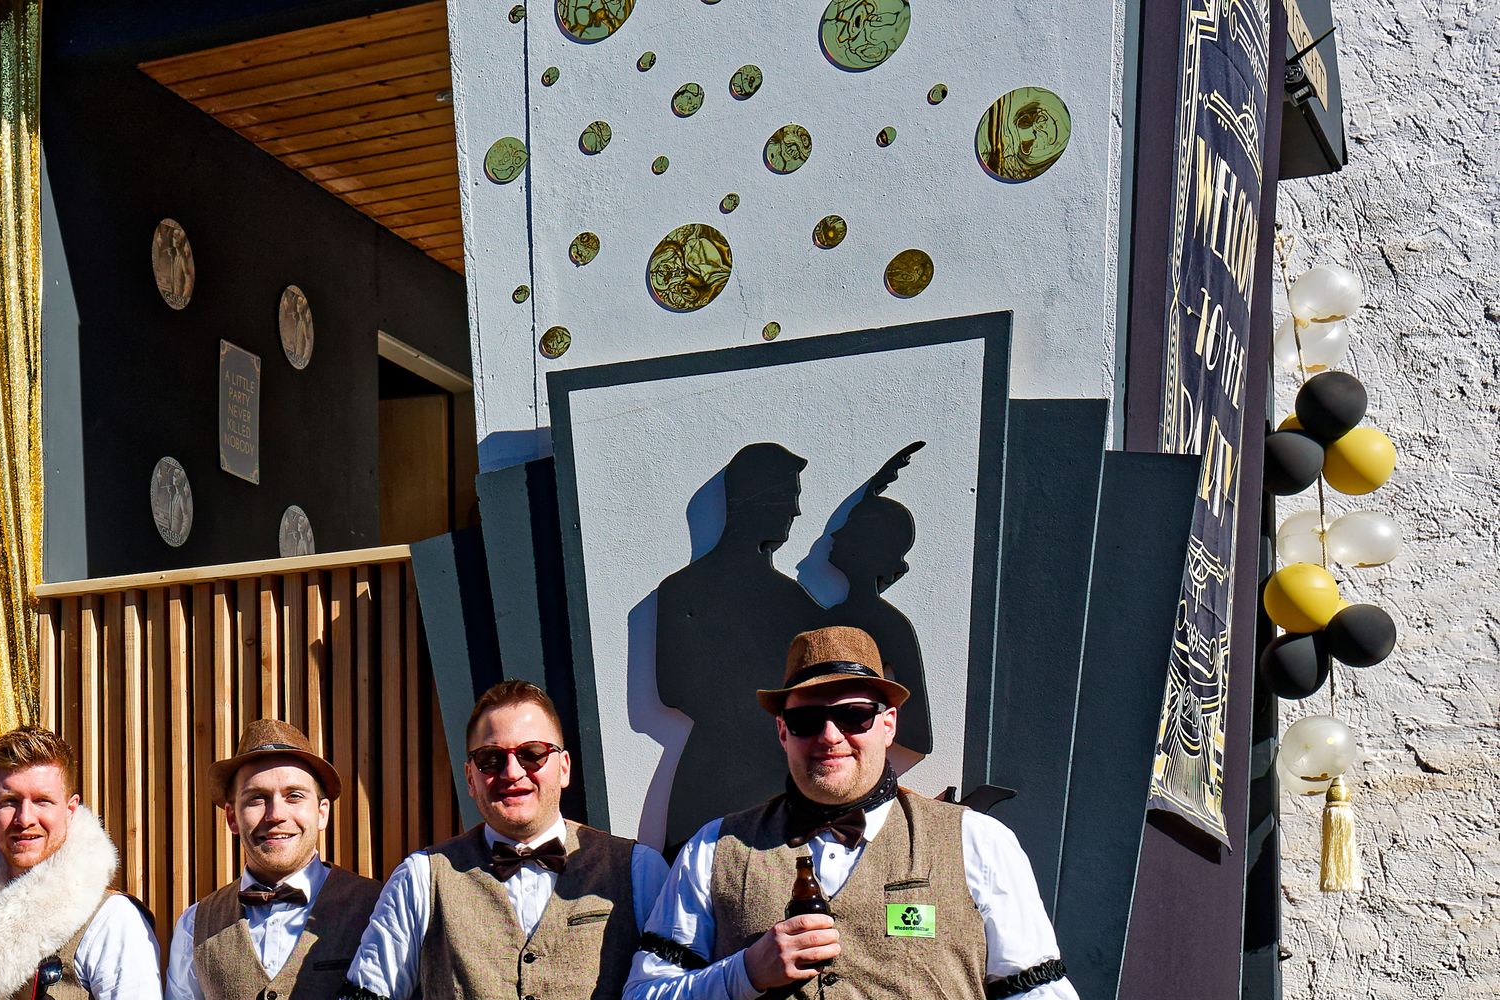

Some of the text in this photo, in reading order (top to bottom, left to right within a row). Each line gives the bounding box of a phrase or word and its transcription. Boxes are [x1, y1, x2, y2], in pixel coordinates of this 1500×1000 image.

[1195, 287, 1245, 410] TO THE
[225, 370, 255, 394] A LITTLE
[228, 386, 250, 407] PARTY
[228, 403, 251, 424] NEVER
[227, 417, 251, 439] KILLED
[224, 433, 255, 457] NOBODY
